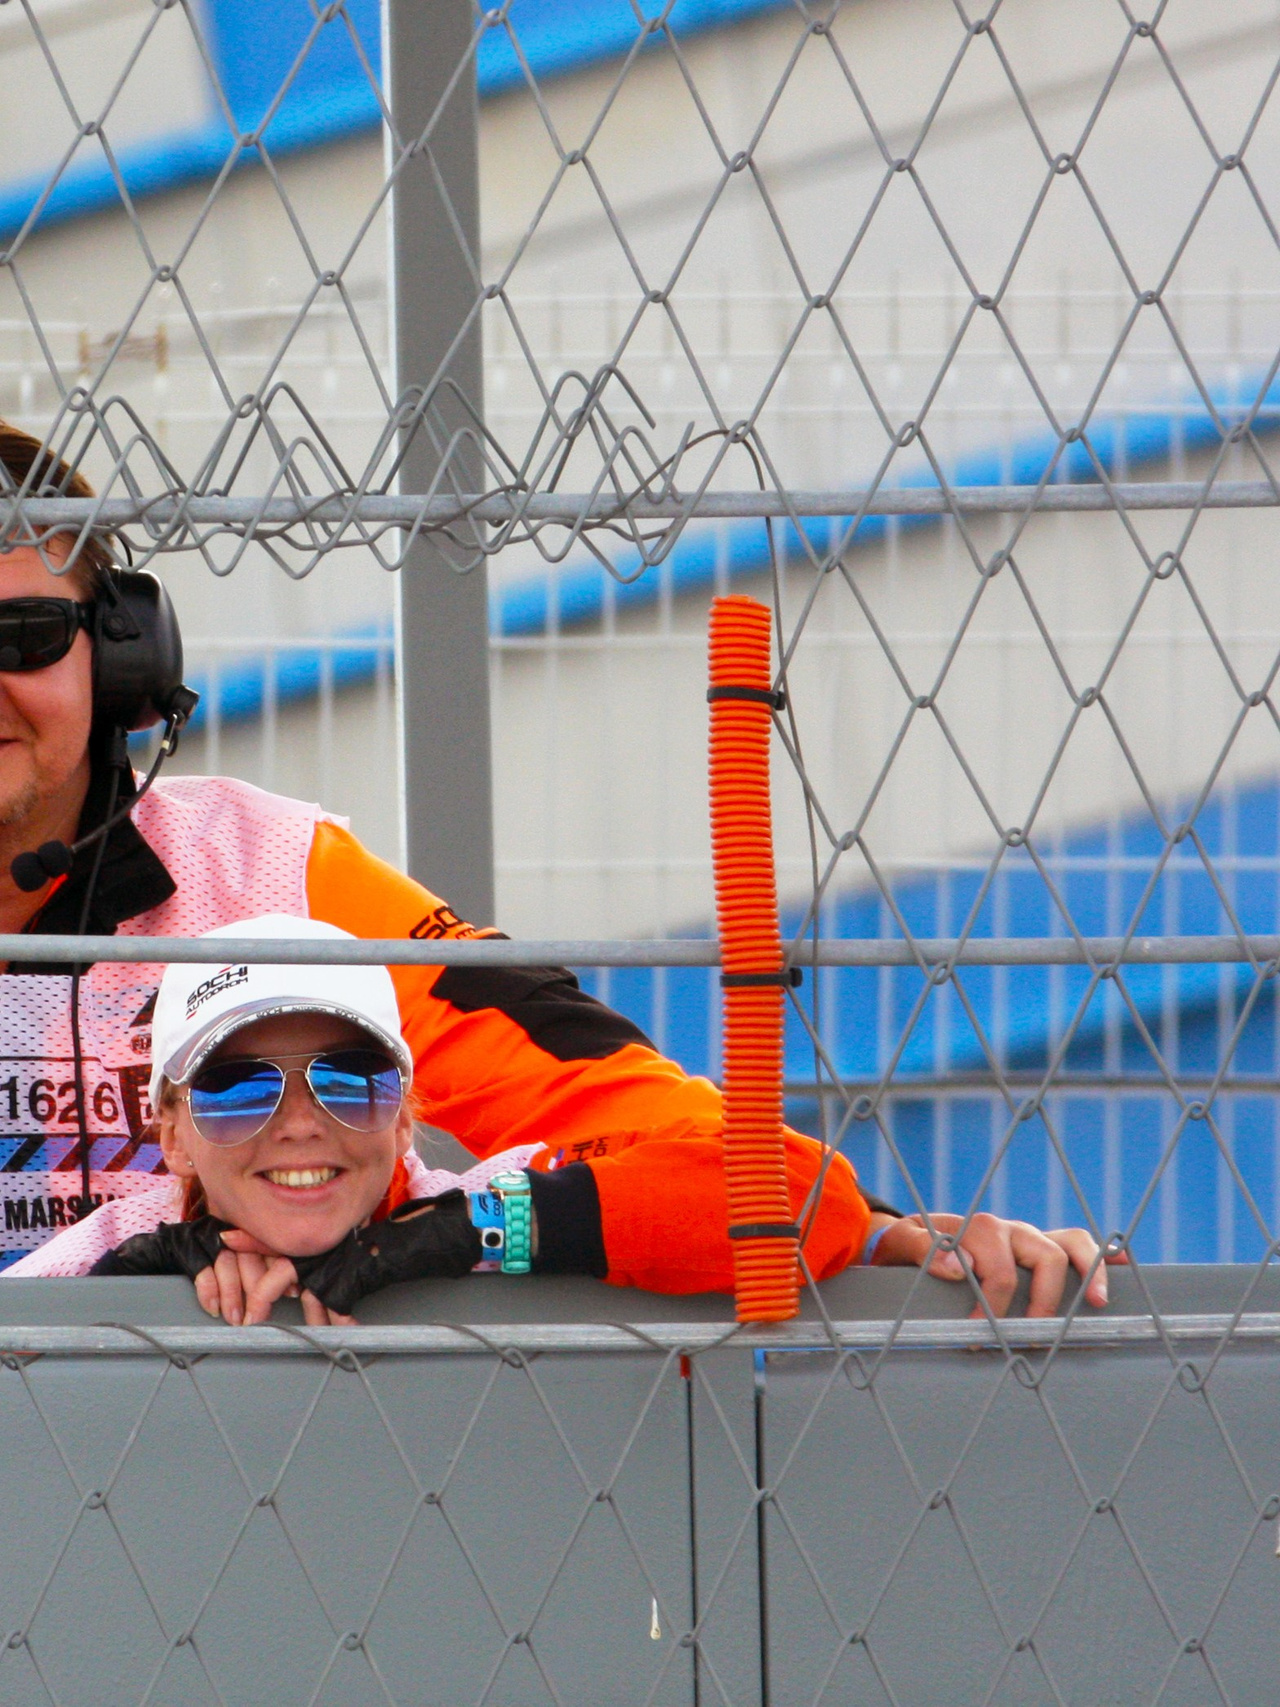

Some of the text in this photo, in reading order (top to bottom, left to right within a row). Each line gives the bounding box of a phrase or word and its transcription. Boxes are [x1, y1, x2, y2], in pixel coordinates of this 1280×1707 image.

[185, 976, 249, 1016] AUTODROM
[186, 965, 249, 1008] SOCHI
[4, 1194, 125, 1230] MARS
